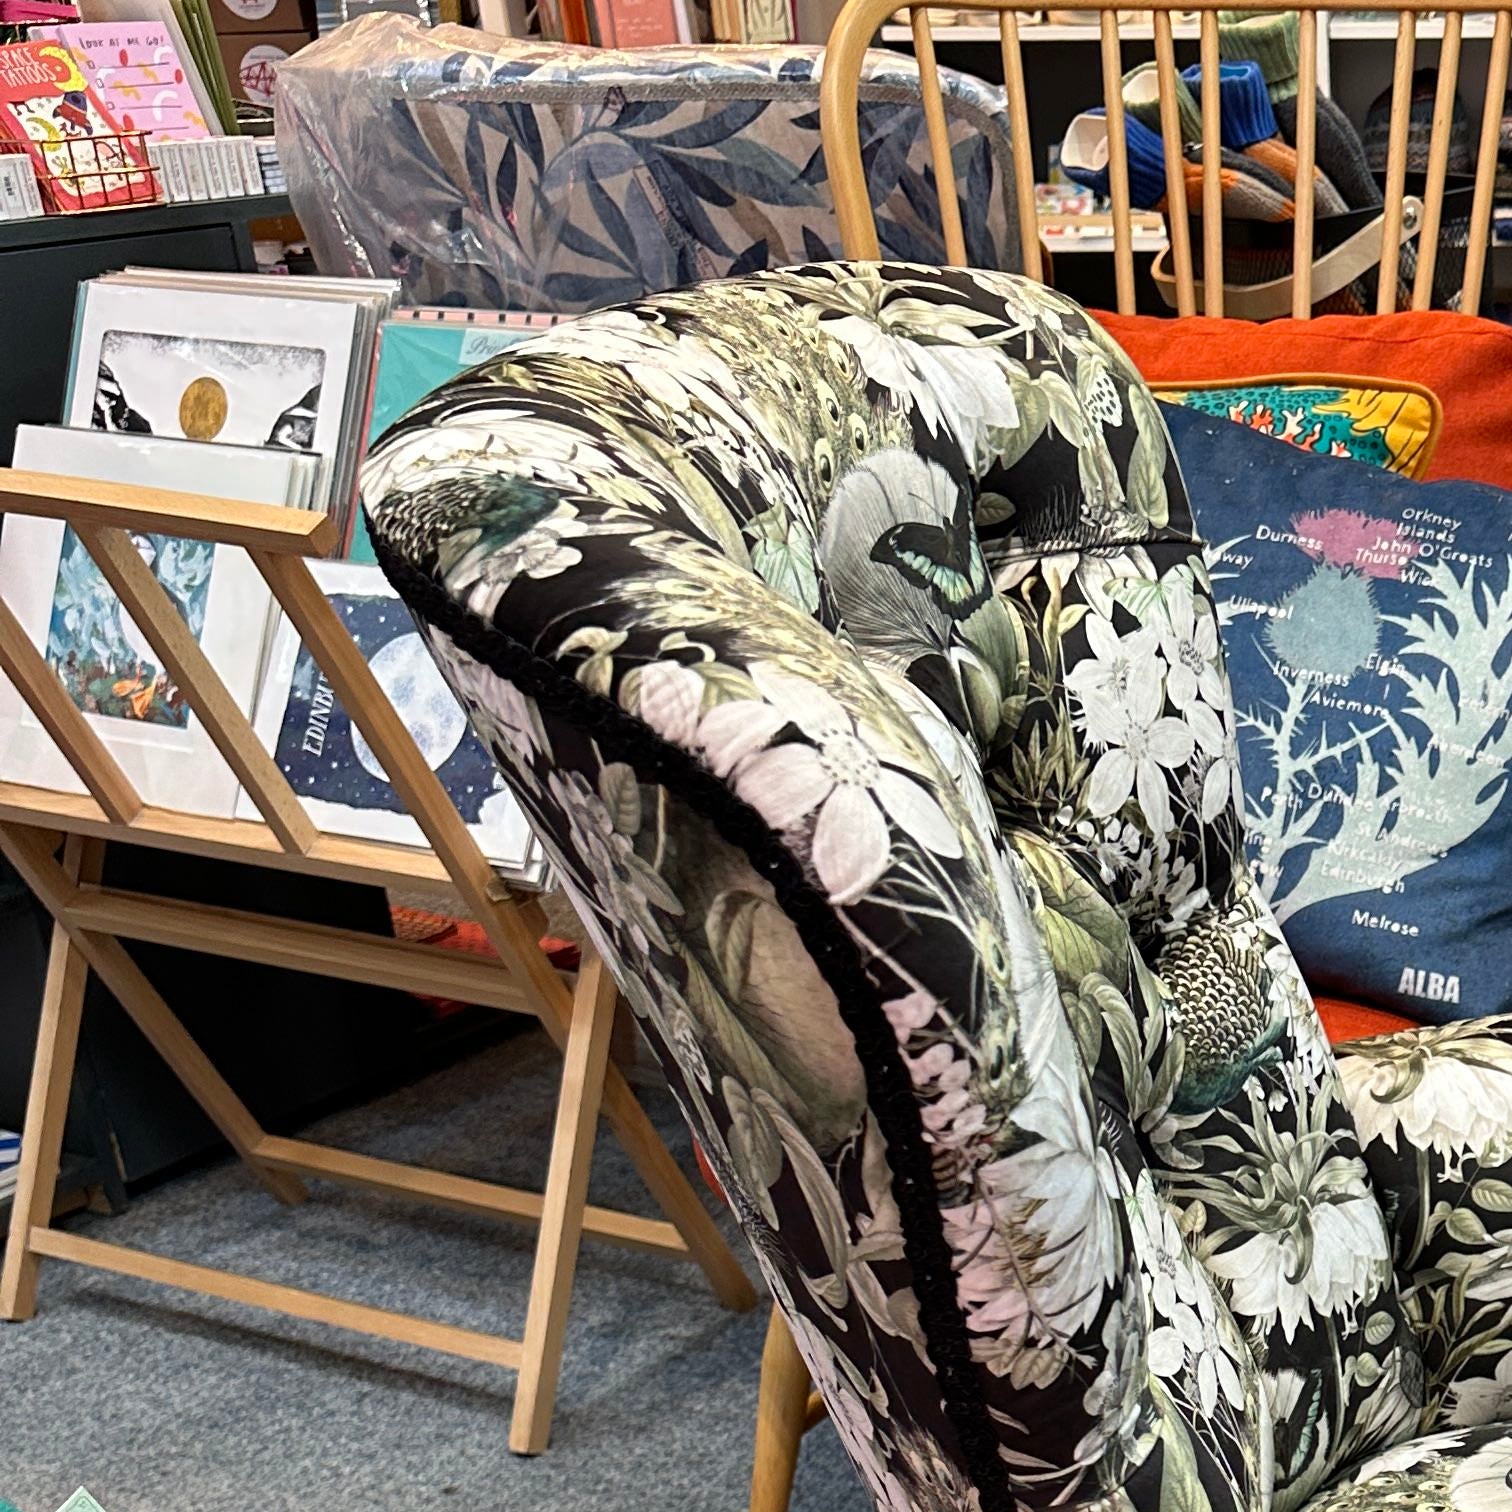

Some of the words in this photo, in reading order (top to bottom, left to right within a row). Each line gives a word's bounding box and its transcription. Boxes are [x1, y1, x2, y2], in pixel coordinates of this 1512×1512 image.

[0, 47, 39, 69] SPACE
[1402, 507, 1462, 531] Orkney
[1256, 525, 1324, 551] Durness
[1396, 523, 1456, 544] Islands
[1355, 548, 1408, 566] Thurso
[1372, 536, 1411, 553] John
[1418, 543, 1494, 569] O'Groats
[1229, 594, 1294, 620] Ullapool
[1273, 660, 1350, 688] Inverness
[1366, 653, 1405, 677] Elgin
[1311, 691, 1390, 719] Aviemore
[1320, 862, 1405, 894] Edinburgh
[1351, 909, 1420, 937] Melrose
[1398, 966, 1460, 1004] ALBA
